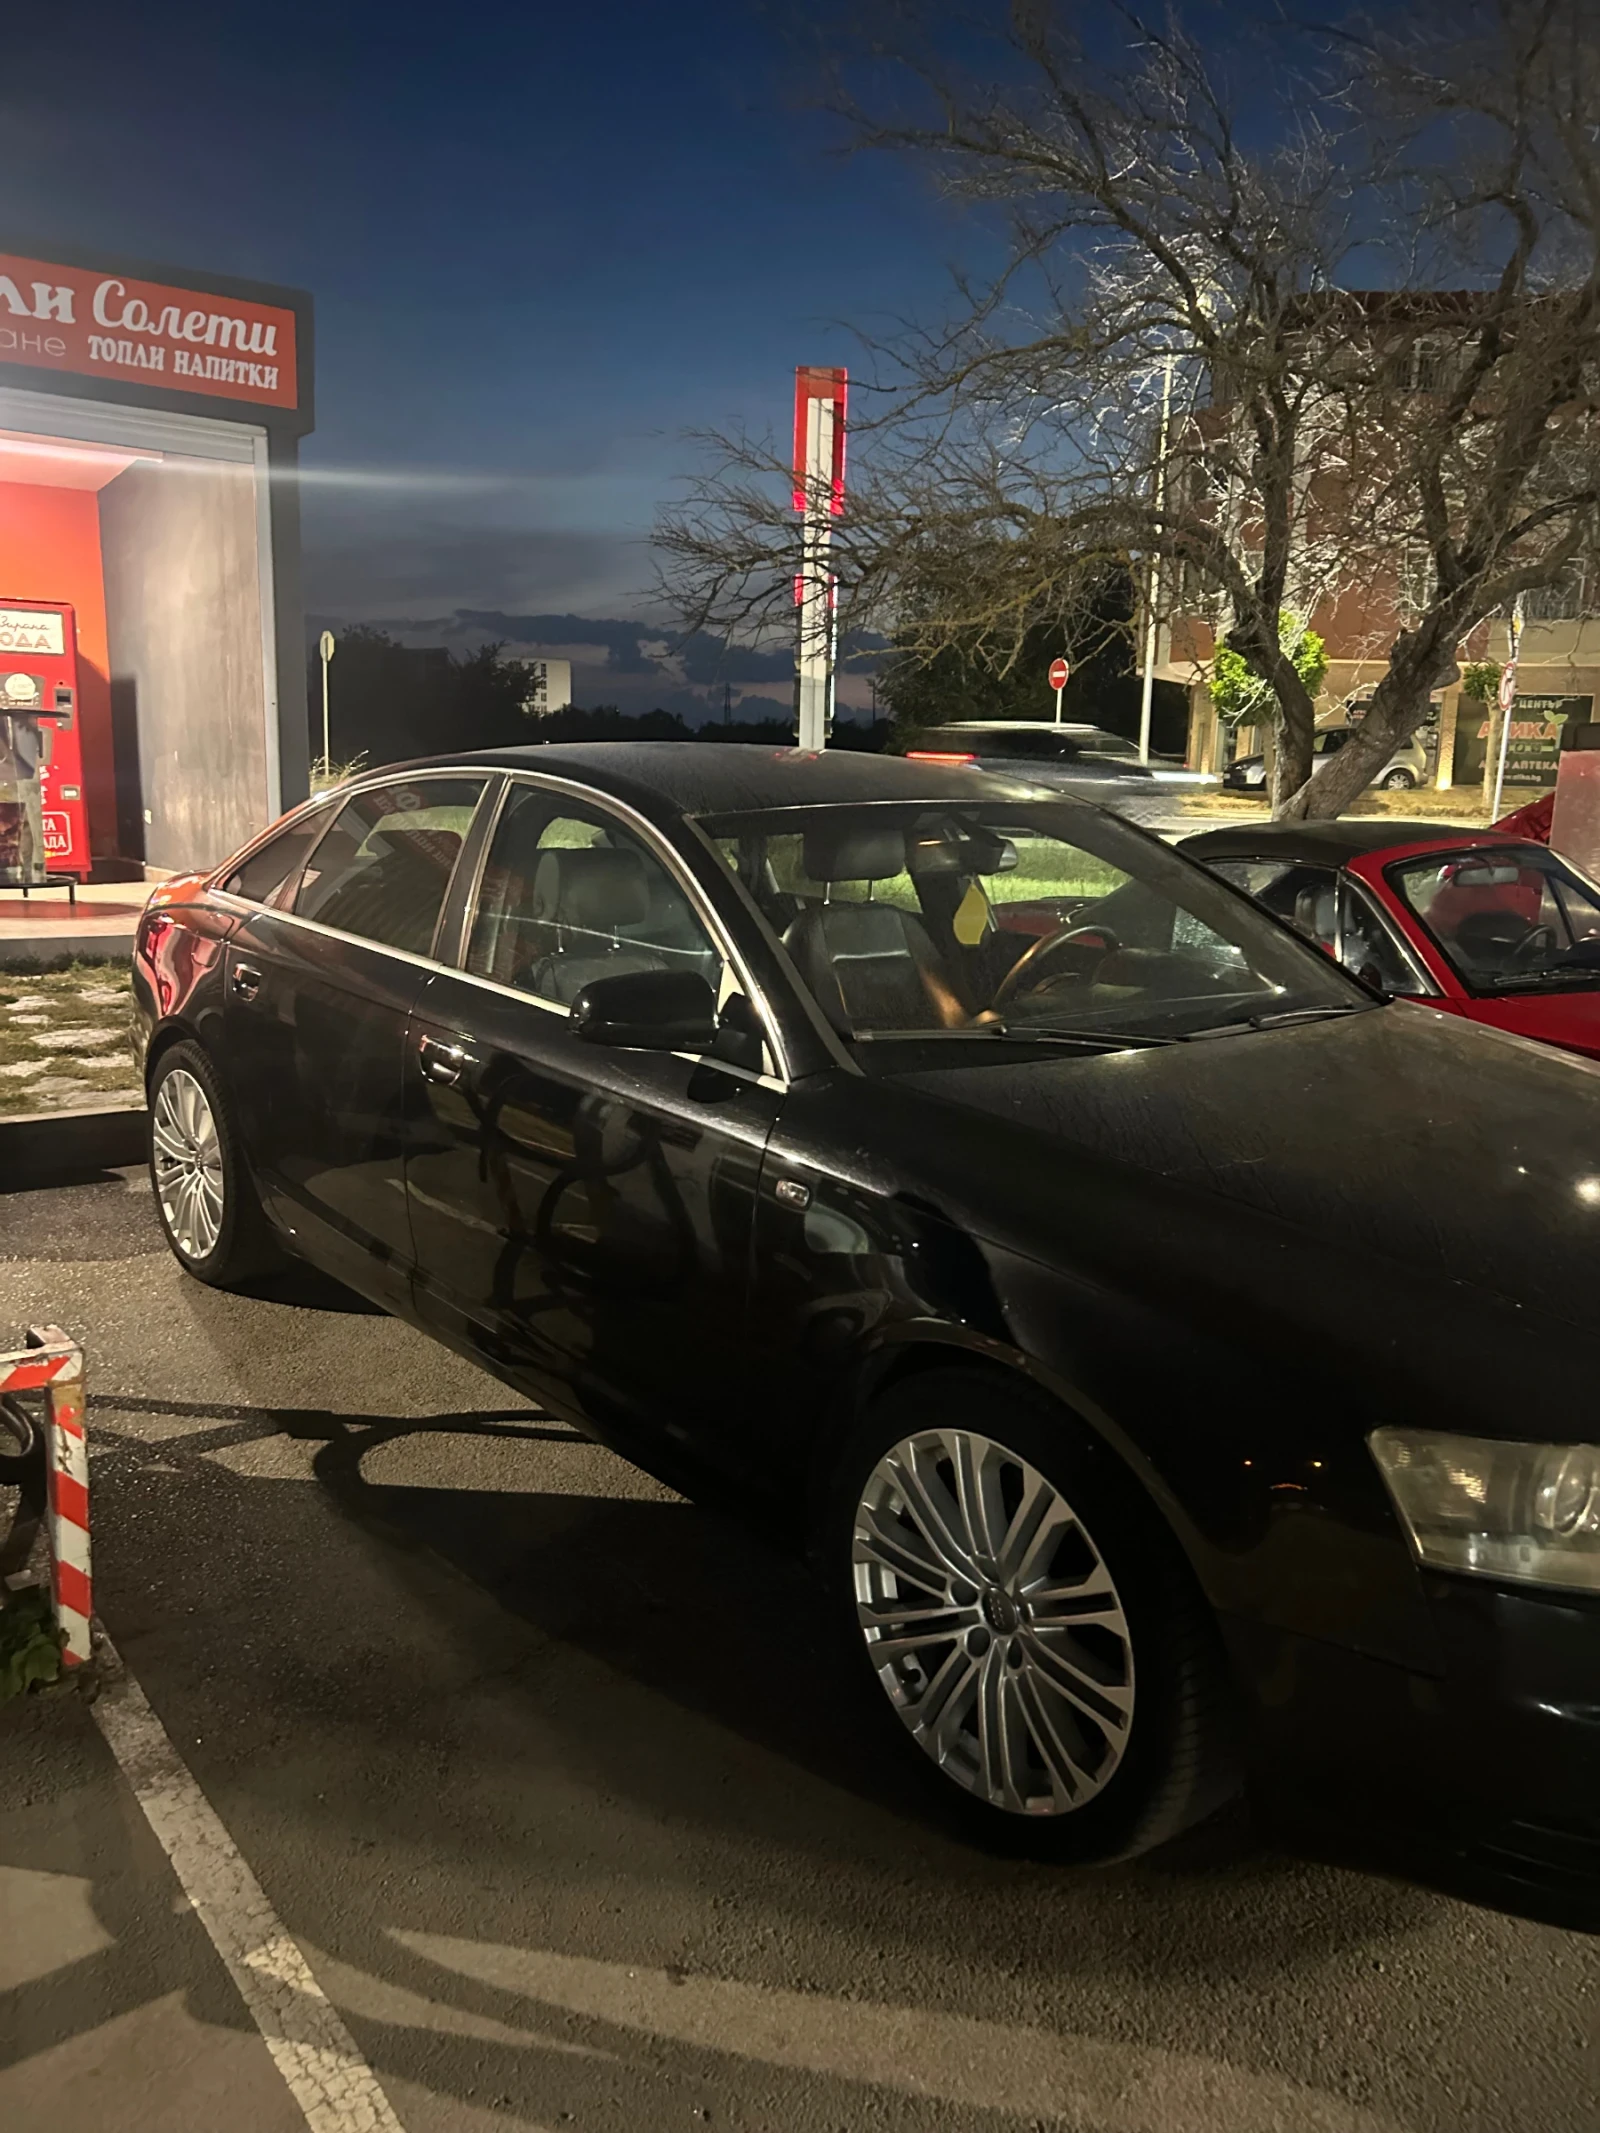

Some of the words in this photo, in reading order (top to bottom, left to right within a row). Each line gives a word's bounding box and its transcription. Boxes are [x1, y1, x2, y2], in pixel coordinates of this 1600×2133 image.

[92, 279, 278, 356] Солети
[87, 334, 165, 372] ТОПЛИ
[173, 350, 279, 390] НАПИТКИ
[1476, 721, 1557, 739] АИКА
